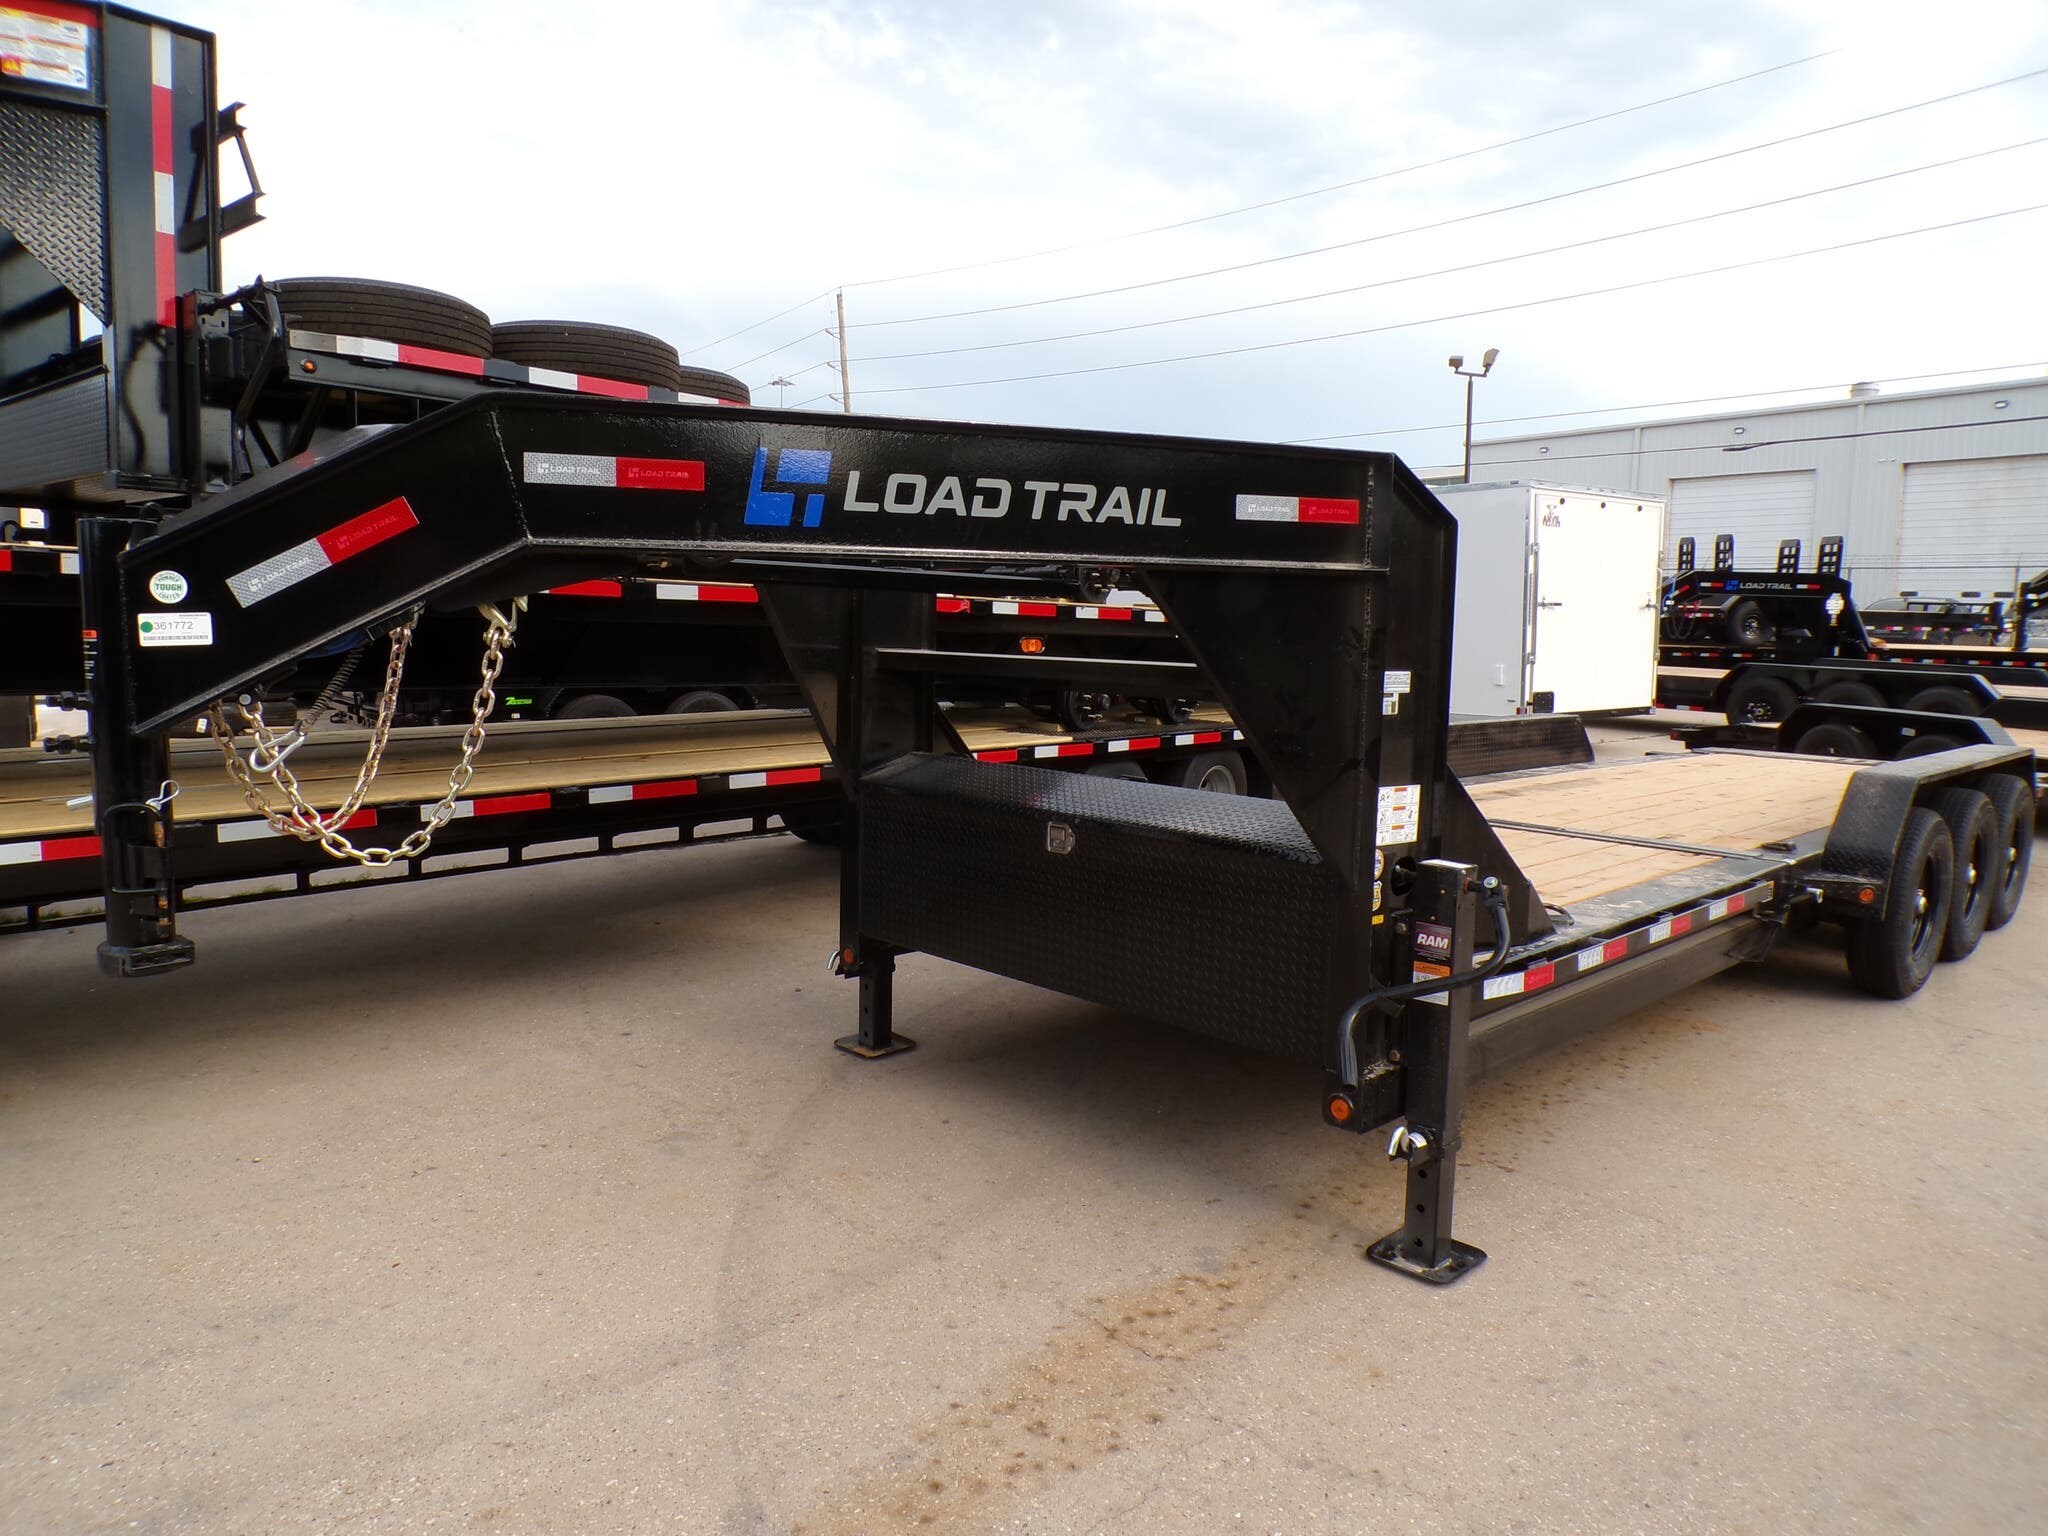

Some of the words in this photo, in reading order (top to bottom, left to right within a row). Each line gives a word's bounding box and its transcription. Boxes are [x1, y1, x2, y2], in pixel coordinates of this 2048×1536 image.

[550, 465, 575, 474] LOAD
[575, 466, 602, 475] TRAIL
[640, 469, 664, 477] LOAD
[844, 470, 1012, 518] LOAD
[1024, 481, 1182, 527] TRAIL
[260, 568, 287, 584] LOAD
[287, 556, 313, 572] TRAIL
[155, 583, 182, 591] TOUGH
[154, 621, 193, 630] 361772
[1417, 933, 1449, 949] RAM
